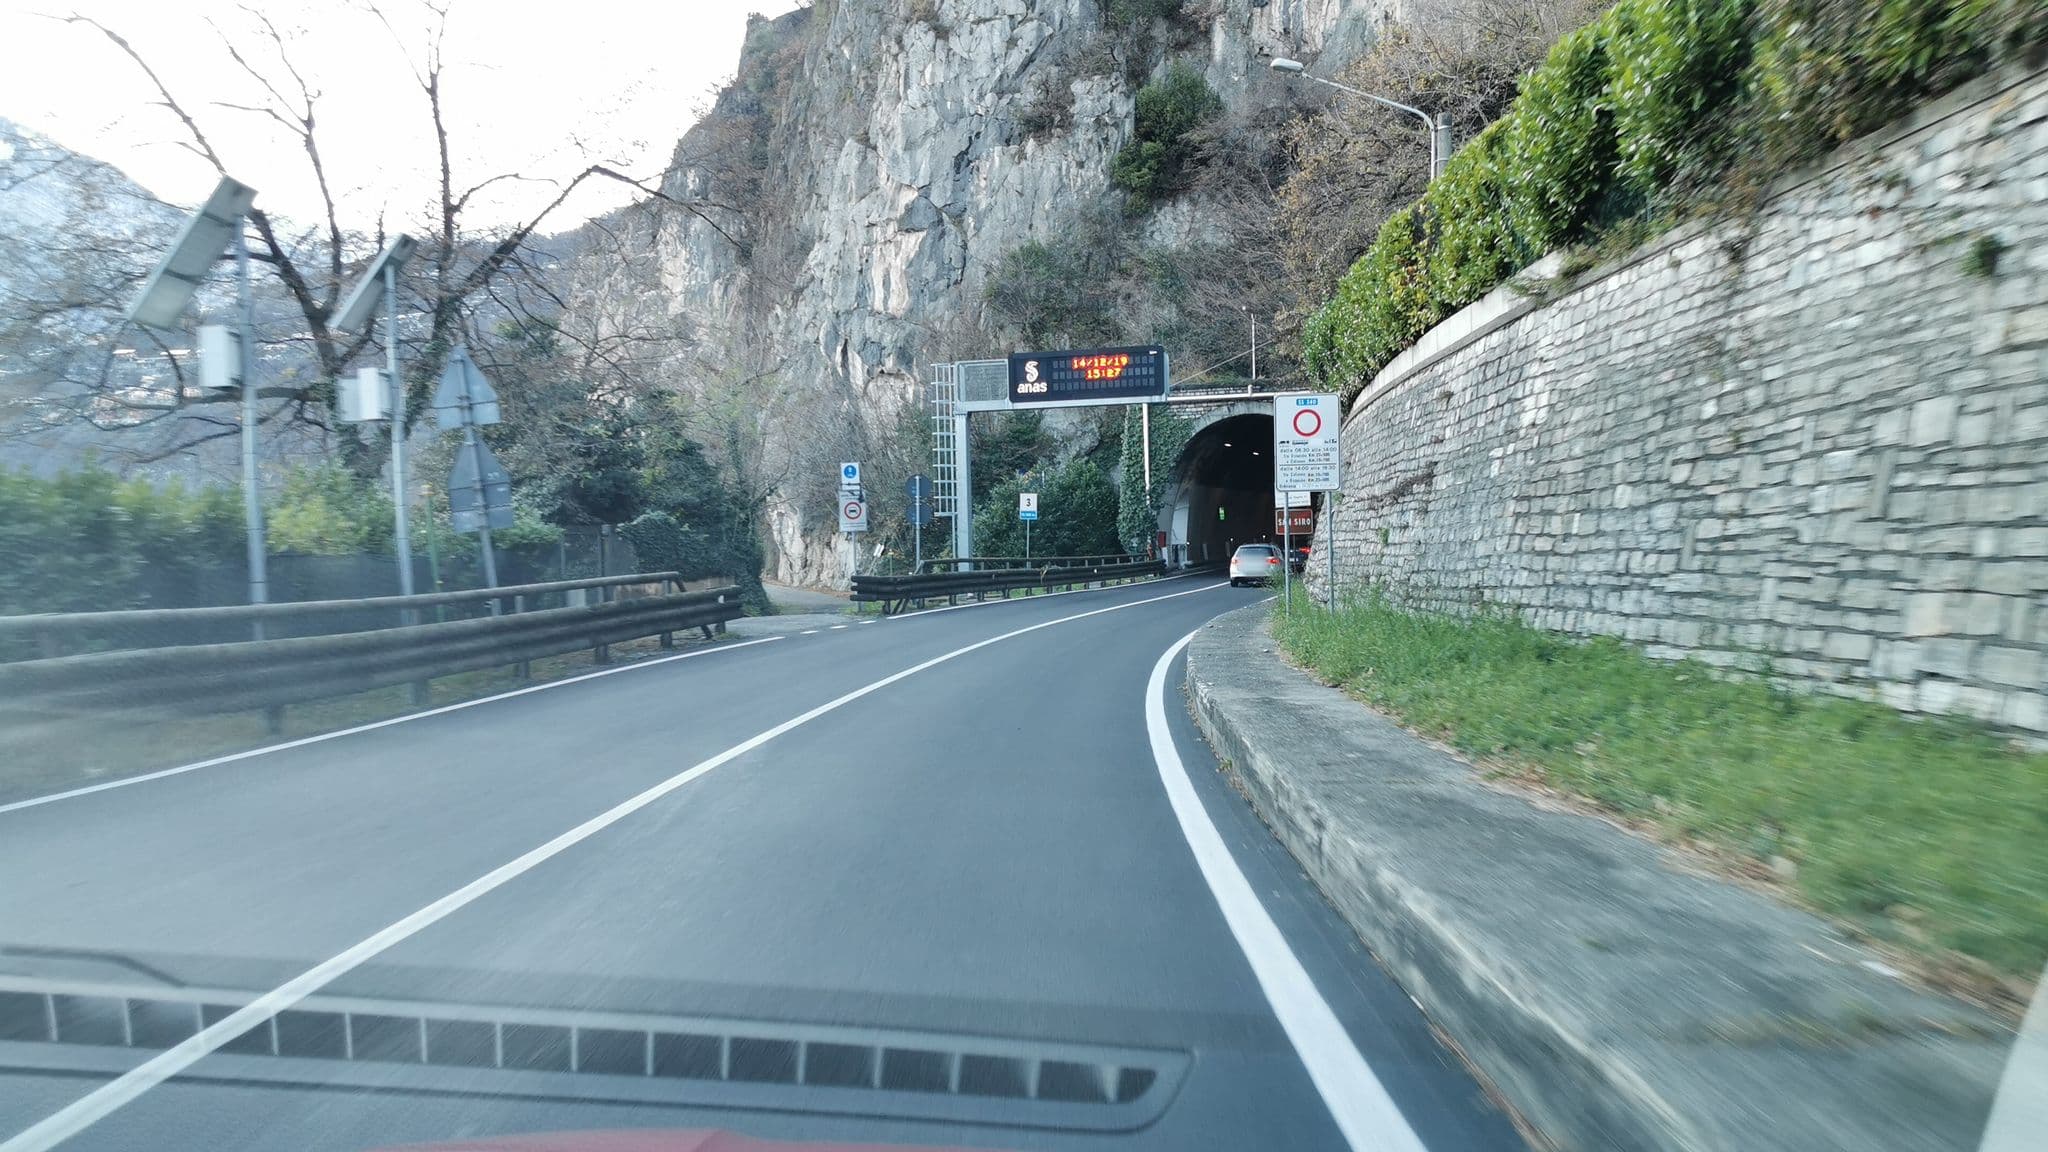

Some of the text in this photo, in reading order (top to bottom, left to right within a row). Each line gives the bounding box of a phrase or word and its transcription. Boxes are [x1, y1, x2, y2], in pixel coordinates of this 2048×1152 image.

[1072, 356, 1128, 369] 14/12/19
[1087, 367, 1121, 380] 15:27
[1017, 382, 1047, 393] anas
[1026, 498, 1031, 507] 3
[1294, 518, 1311, 526] SIRO
